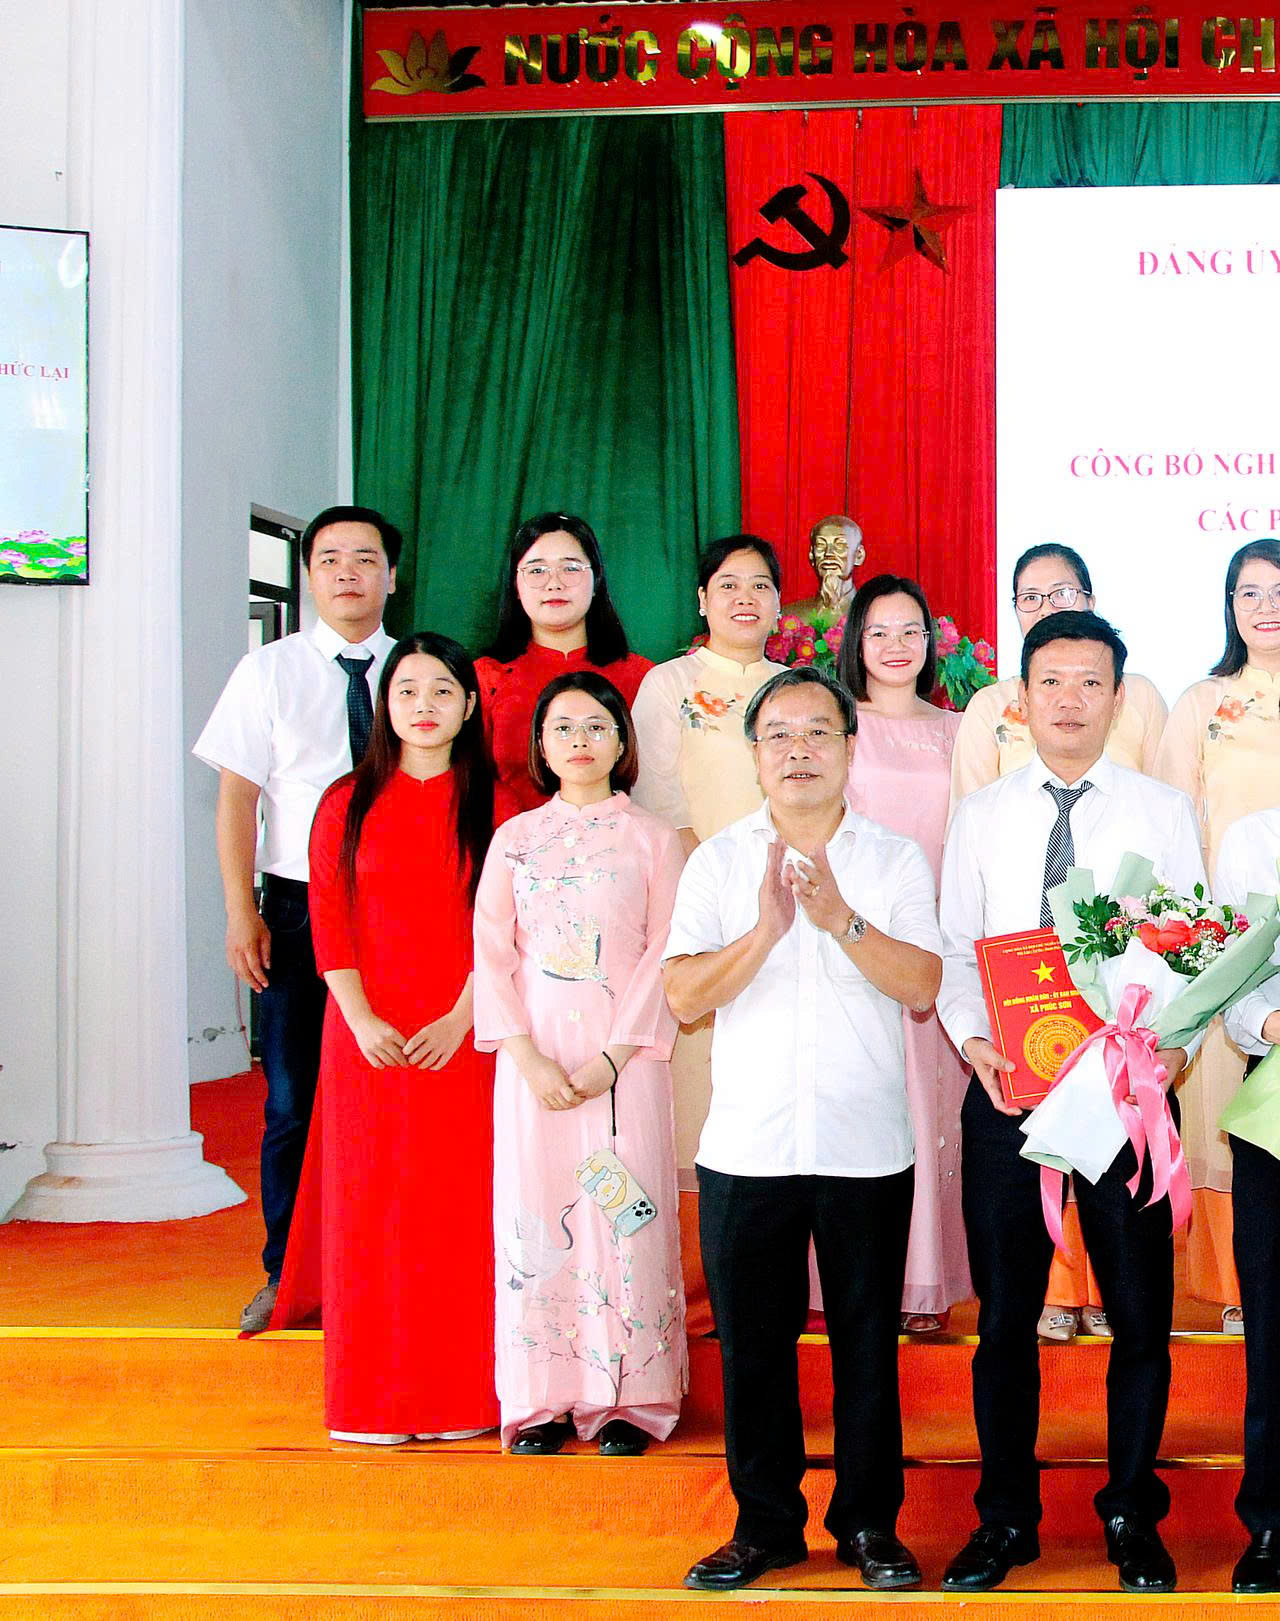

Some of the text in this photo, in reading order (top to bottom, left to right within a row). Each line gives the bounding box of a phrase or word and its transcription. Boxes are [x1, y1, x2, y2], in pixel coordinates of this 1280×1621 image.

[504, 14, 661, 86] NƯỚC
[677, 13, 833, 90] CỘNG
[853, 8, 968, 73] HÒA
[987, 7, 1065, 70] XÃ
[1085, 5, 1180, 80] HỘI
[1138, 244, 1233, 276] ĐẢNG
[0, 361, 69, 381] HỨC LẠI
[1069, 447, 1154, 478] CÔNG
[1197, 502, 1259, 532] CÁC
